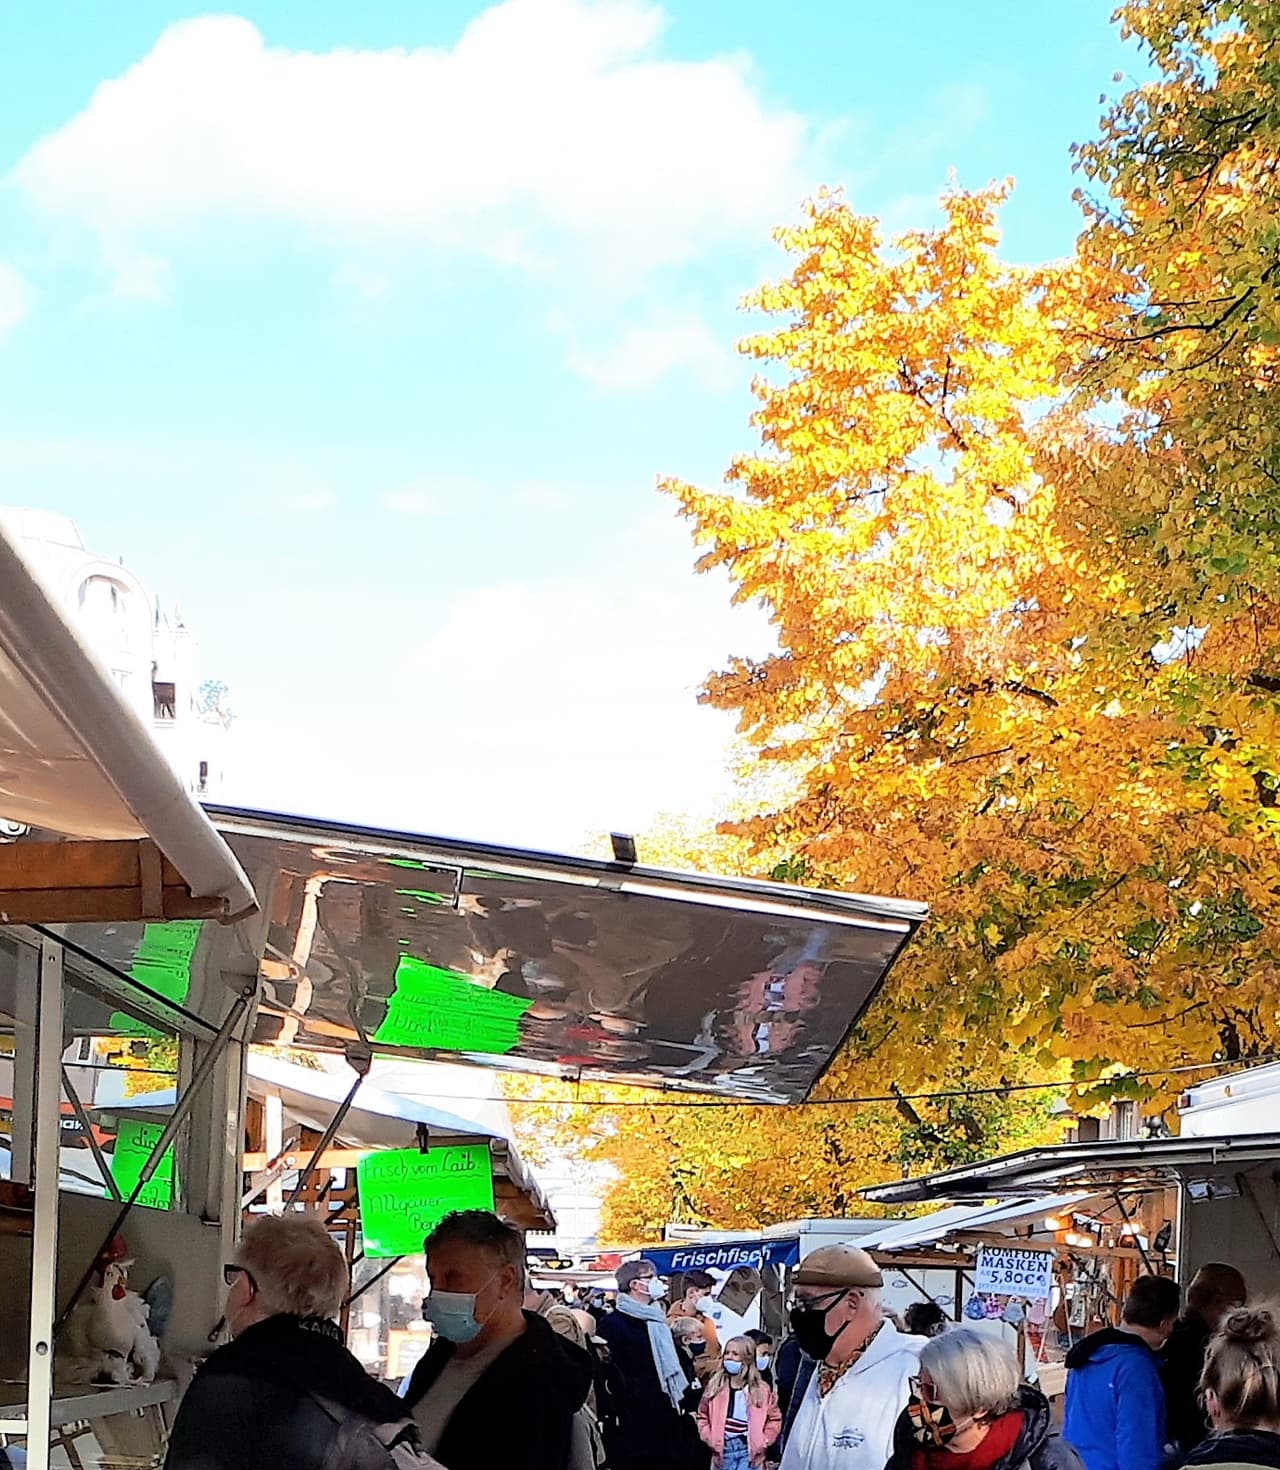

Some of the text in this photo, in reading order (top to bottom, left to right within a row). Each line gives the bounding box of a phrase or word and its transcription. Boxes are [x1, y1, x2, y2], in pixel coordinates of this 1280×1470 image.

[411, 1164, 438, 1177] vom
[671, 1247, 771, 1269] Frischfisch
[982, 1247, 1048, 1261] KOMFORT
[980, 1256, 1049, 1273] MASKEN
